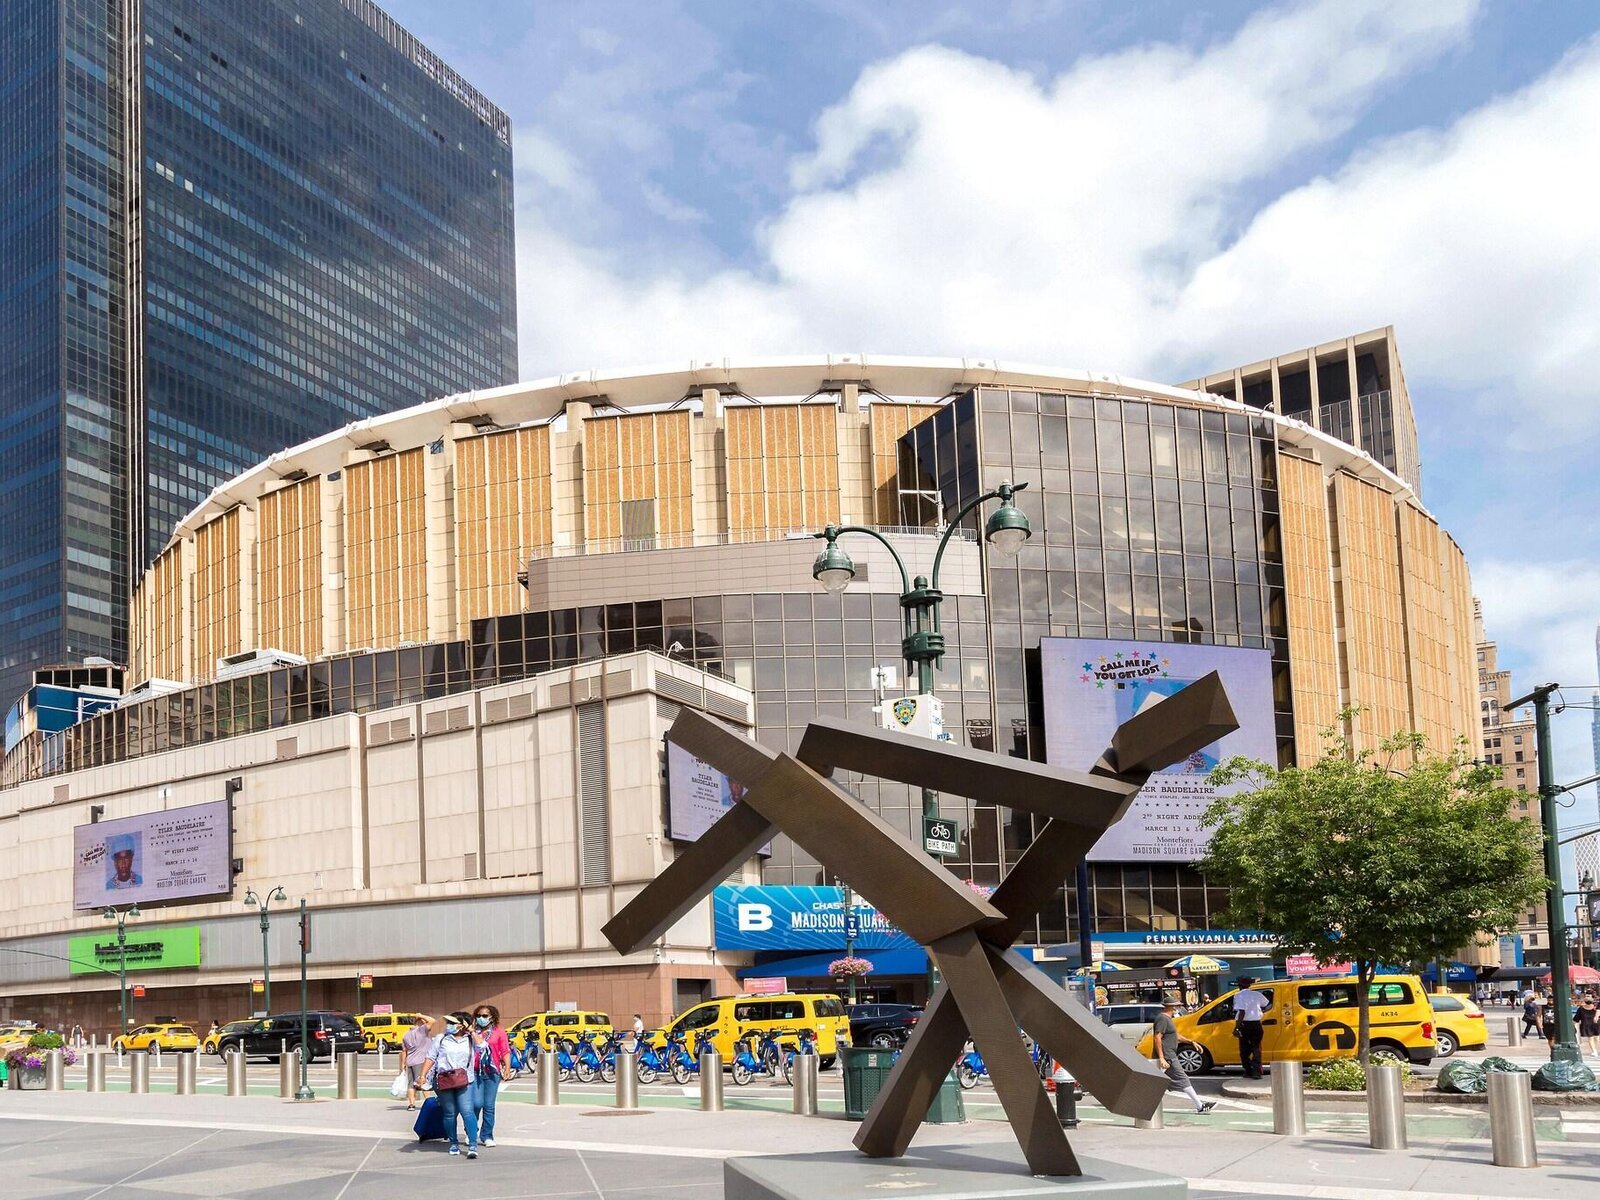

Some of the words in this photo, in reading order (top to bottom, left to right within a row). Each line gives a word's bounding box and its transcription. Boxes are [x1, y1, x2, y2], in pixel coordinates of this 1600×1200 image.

[1100, 661, 1124, 672] CALL
[1094, 672, 1116, 680] YOU
[1118, 670, 1136, 679] GET
[1138, 665, 1160, 676] LOST
[1161, 786, 1214, 794] BAUDELAIRE
[928, 840, 939, 849] BIKE
[942, 842, 954, 851] PATH
[190, 876, 206, 884] GARDEN
[813, 902, 843, 910] CHAS
[738, 904, 773, 931] B
[792, 912, 844, 928] MADISON
[1146, 934, 1234, 942] PENNSYLVANIA
[1239, 934, 1280, 942] STATIO
